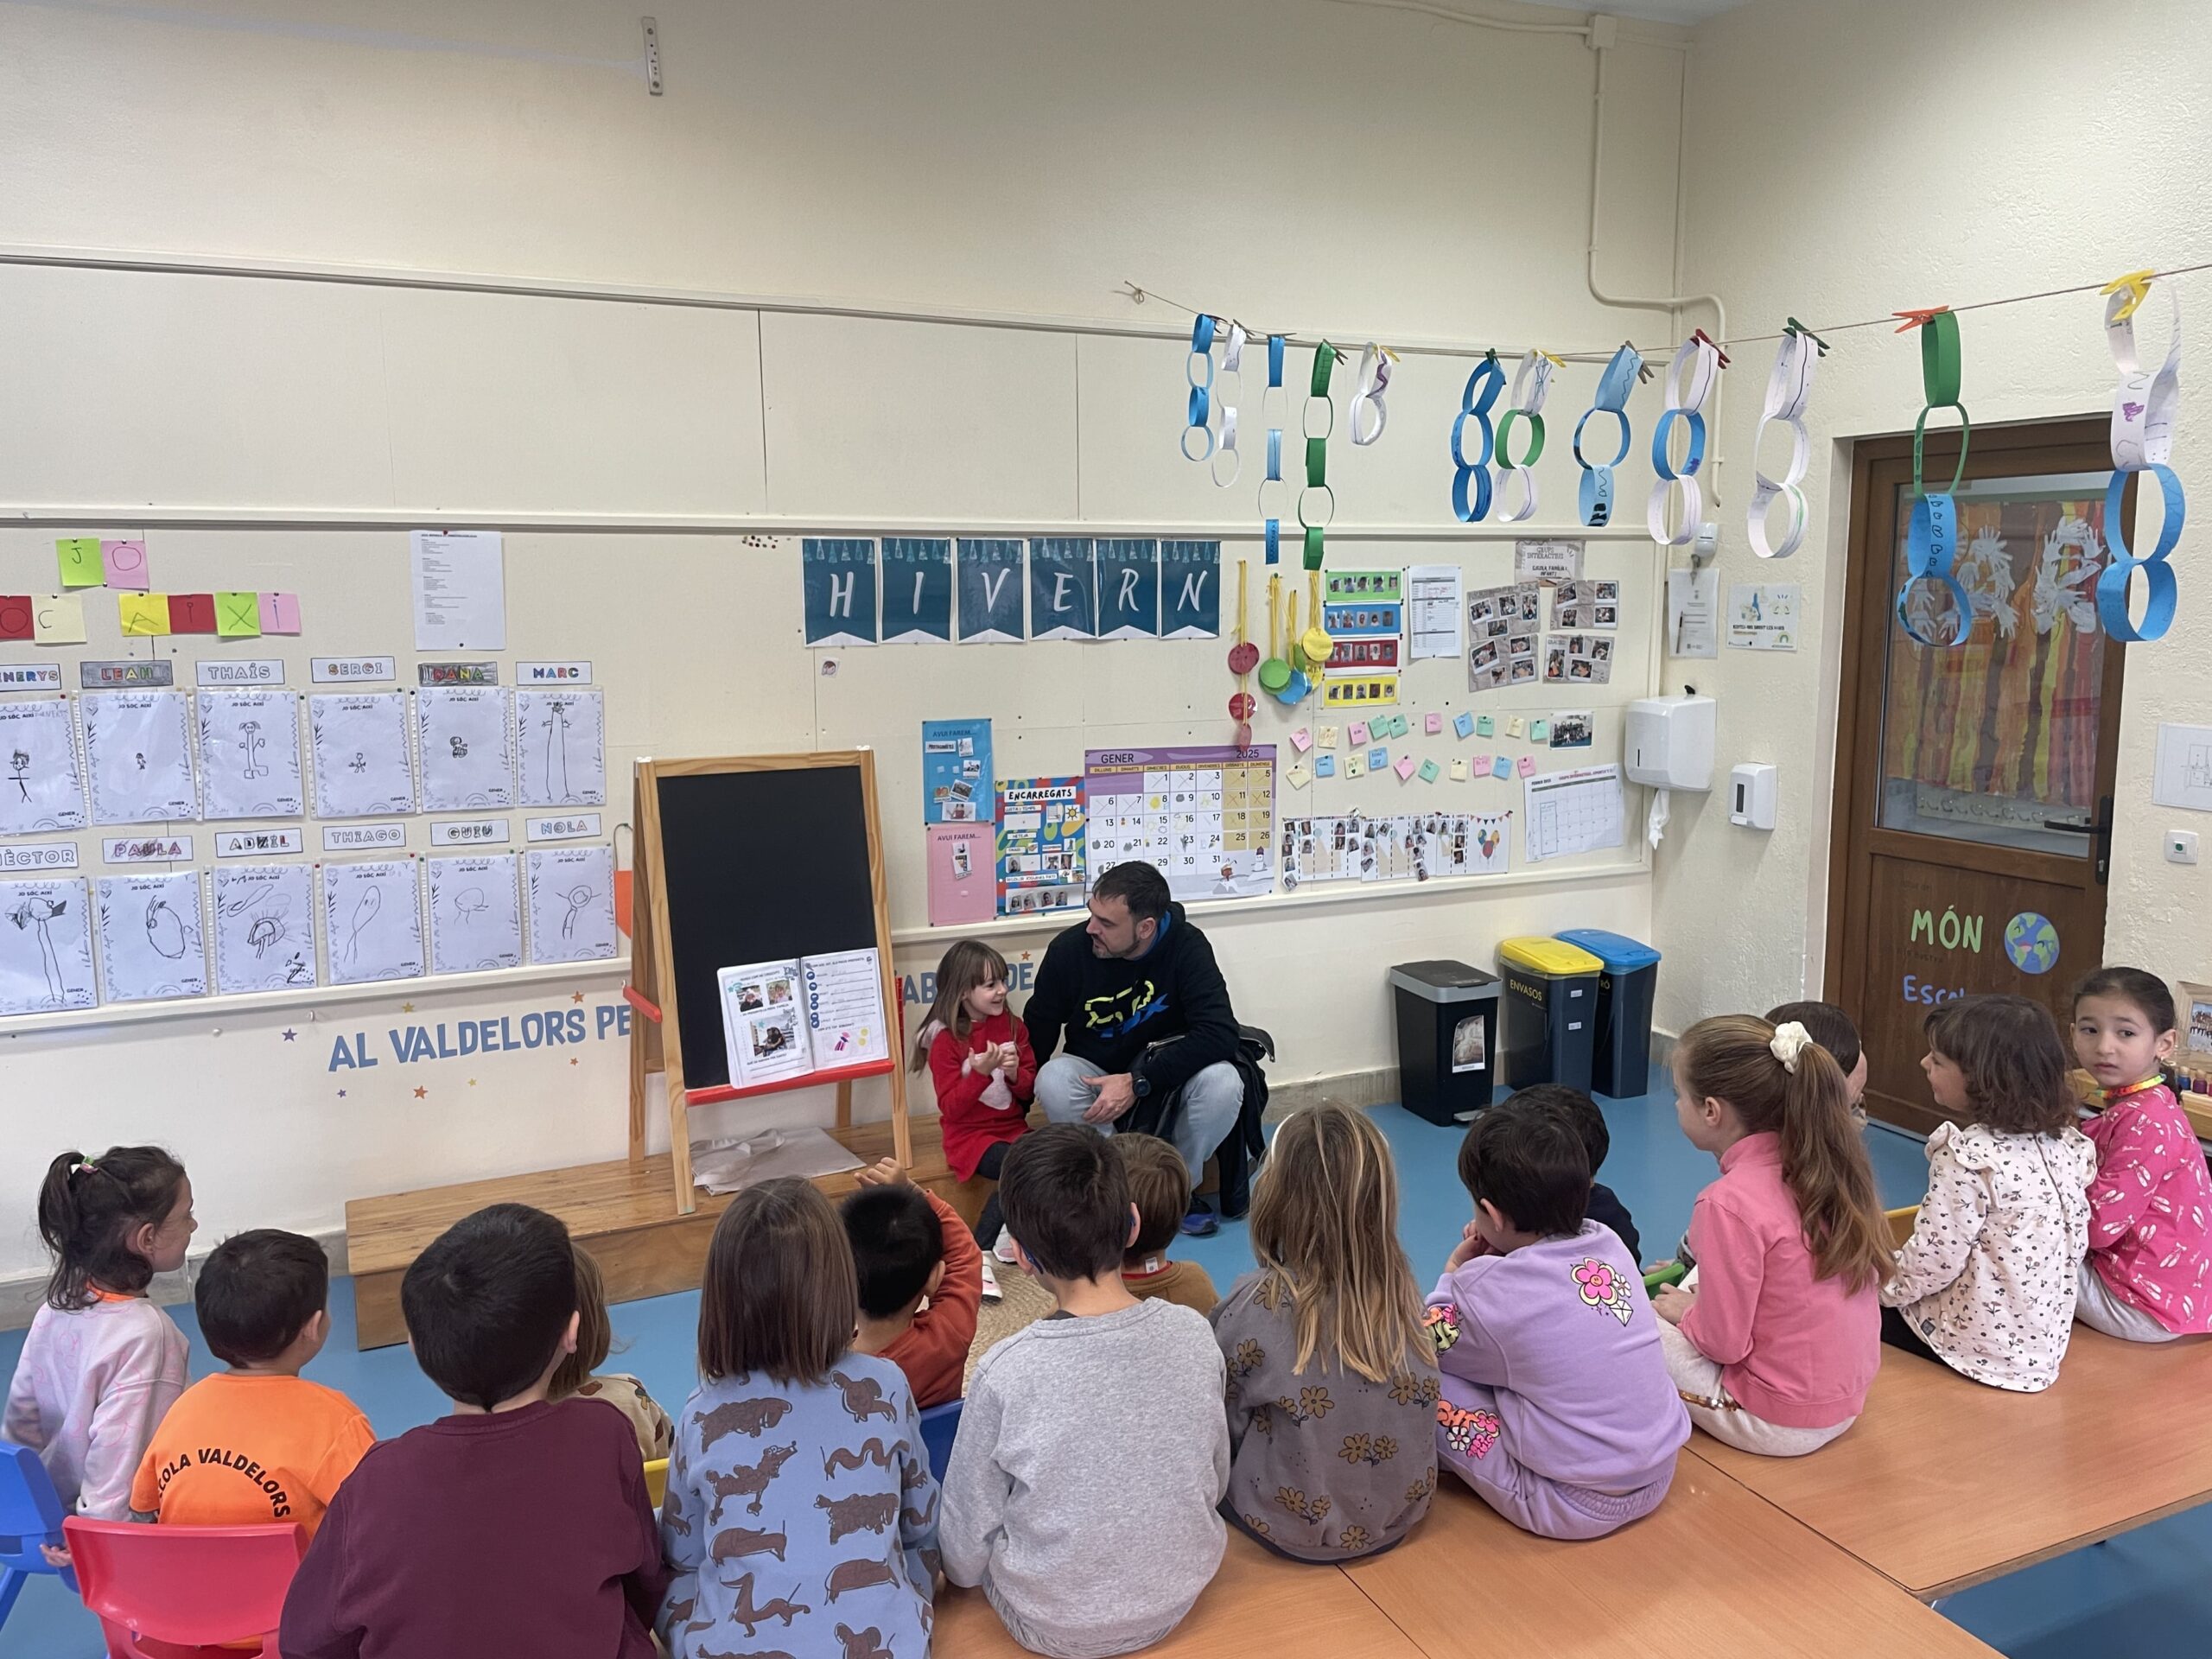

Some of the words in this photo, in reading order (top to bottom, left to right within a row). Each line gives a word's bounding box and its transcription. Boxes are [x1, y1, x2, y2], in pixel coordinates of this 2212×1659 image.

[101, 667, 153, 681] LEAH
[208, 662, 270, 680] THAÍS
[327, 663, 383, 676] SERGI
[532, 667, 579, 679] MARC
[1101, 753, 1135, 764] GENER
[1236, 749, 1260, 759] 2025
[1164, 773, 1167, 782] 1
[1188, 772, 1194, 781] 2
[1265, 769, 1271, 778] 5
[1008, 789, 1072, 801] ENCARREGATS
[1108, 797, 1115, 805] 6
[1188, 793, 1194, 802] 9
[1262, 790, 1270, 798] 12
[1105, 818, 1115, 827] 13
[1133, 817, 1141, 826] 14
[1159, 816, 1167, 824] 15
[1212, 813, 1221, 822] 17
[1262, 810, 1270, 819] 19
[541, 820, 588, 835] NOLA
[332, 829, 401, 843] THIAGO
[1103, 840, 1115, 849] 20
[1133, 838, 1141, 847] 21
[1157, 837, 1168, 846] 22
[1184, 836, 1194, 844] 23
[1210, 834, 1221, 842] 24
[1236, 833, 1246, 842] 25
[1260, 831, 1270, 840] 26
[113, 842, 182, 857] PAULA
[1105, 861, 1116, 870] 27
[1157, 858, 1168, 867] 29
[1184, 856, 1194, 865] 30
[1910, 905, 1984, 954] MÓN
[1510, 979, 1542, 1001] ENVASOS
[328, 1033, 378, 1072] AL
[389, 1008, 587, 1064] VALDELORS
[198, 1447, 291, 1518] VALDELORS
